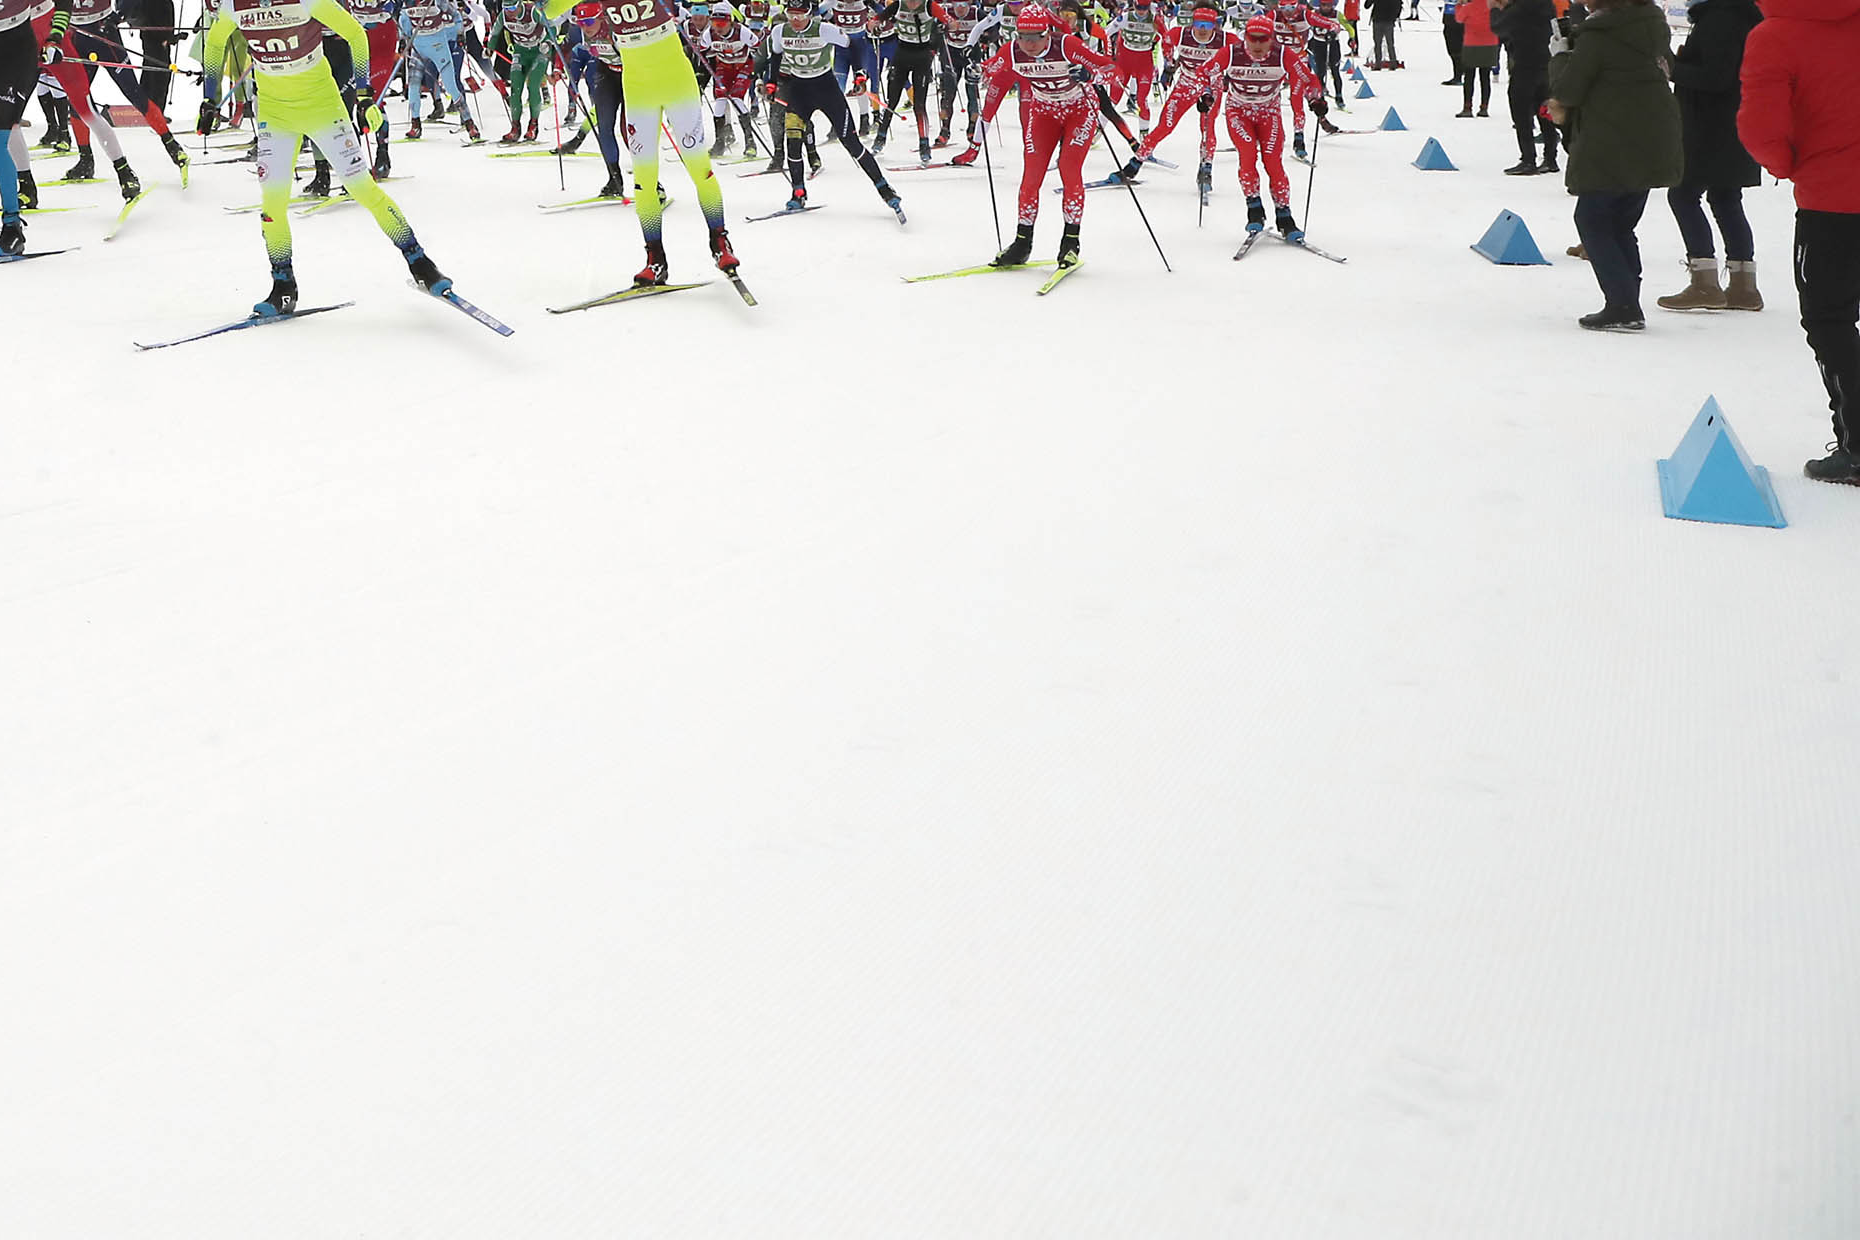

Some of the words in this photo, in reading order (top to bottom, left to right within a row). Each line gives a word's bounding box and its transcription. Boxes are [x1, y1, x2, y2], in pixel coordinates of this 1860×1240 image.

[256, 9, 283, 21] ITAS
[606, 0, 656, 25] 602
[837, 14, 862, 24] 633
